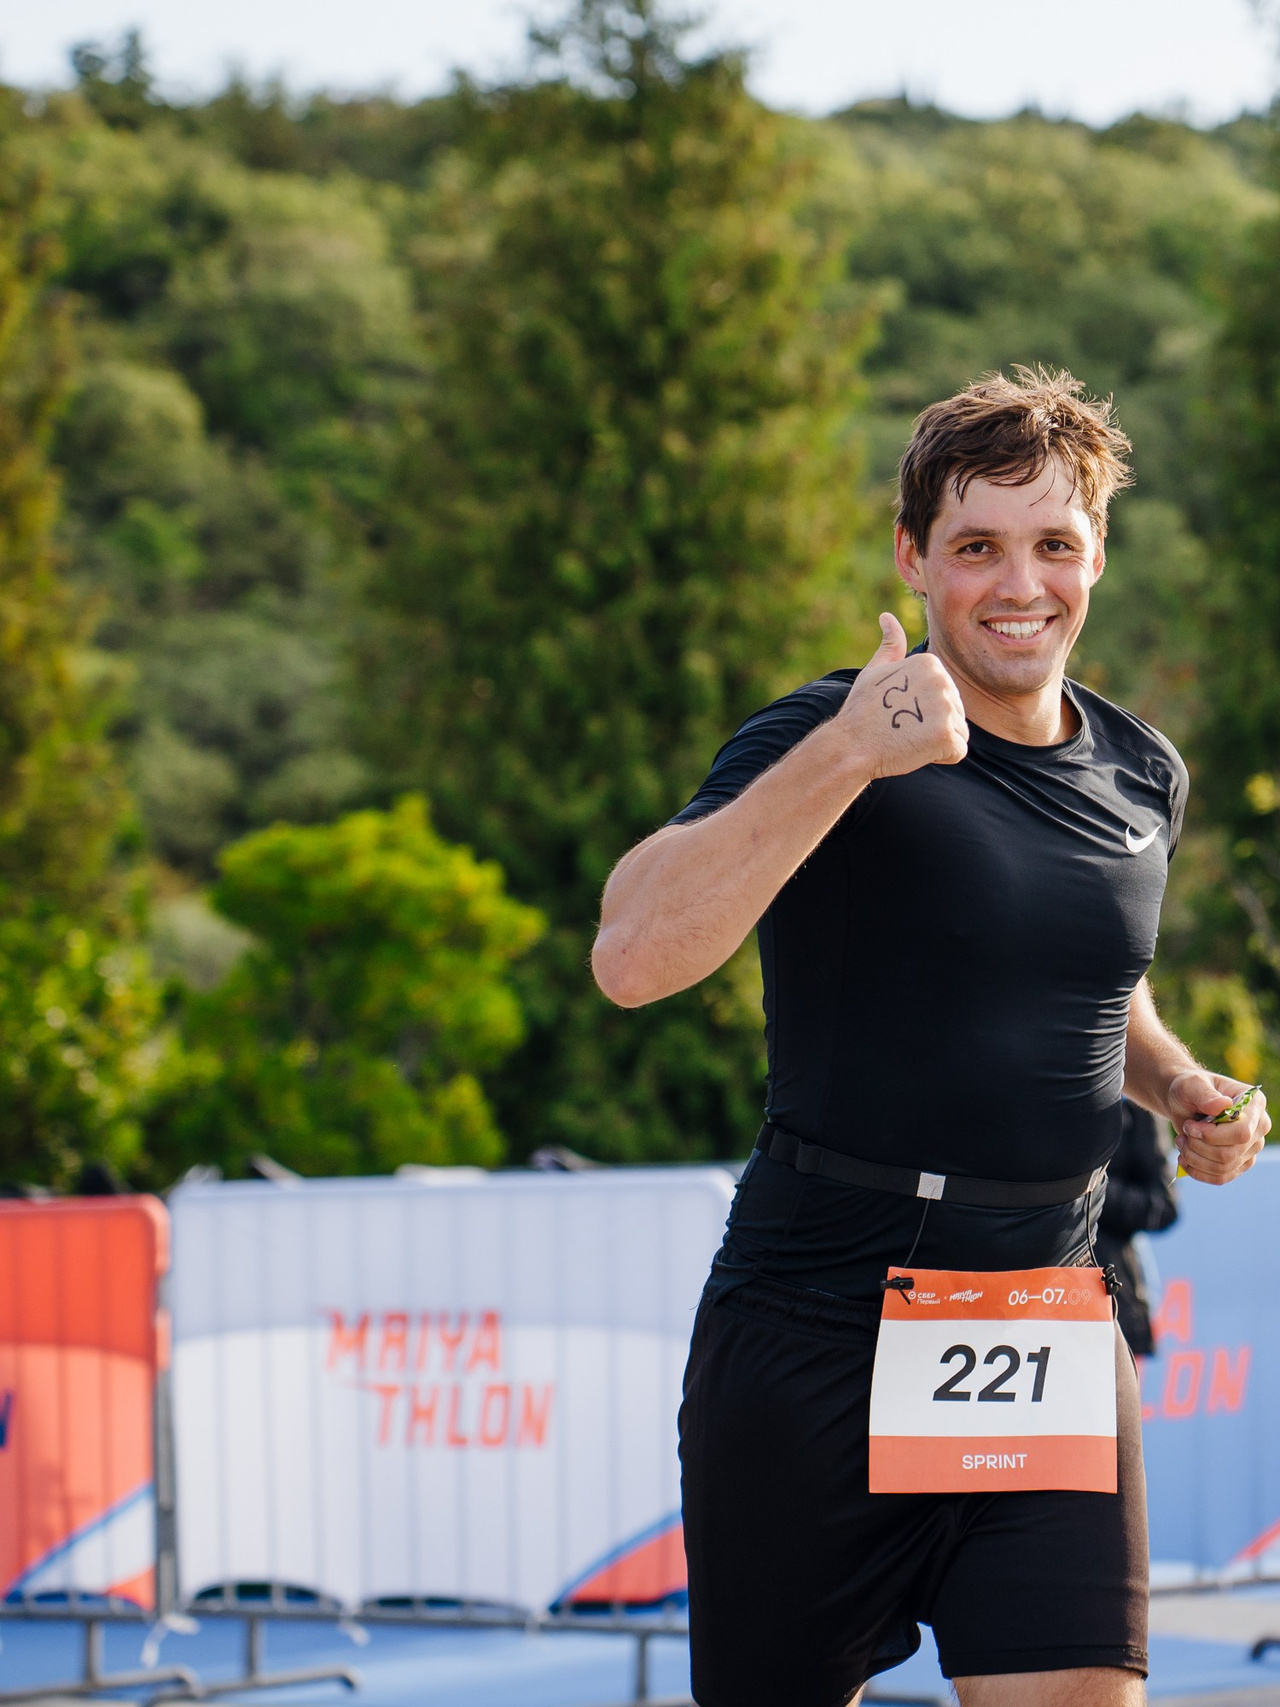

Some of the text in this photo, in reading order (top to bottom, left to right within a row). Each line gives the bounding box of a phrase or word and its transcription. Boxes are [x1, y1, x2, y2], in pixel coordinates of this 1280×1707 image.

[875, 665, 924, 729] 221
[322, 1309, 502, 1372] MAIYA
[932, 1344, 1051, 1402] 221
[364, 1382, 554, 1447] THLON
[962, 1454, 1027, 1470] SPRINT
